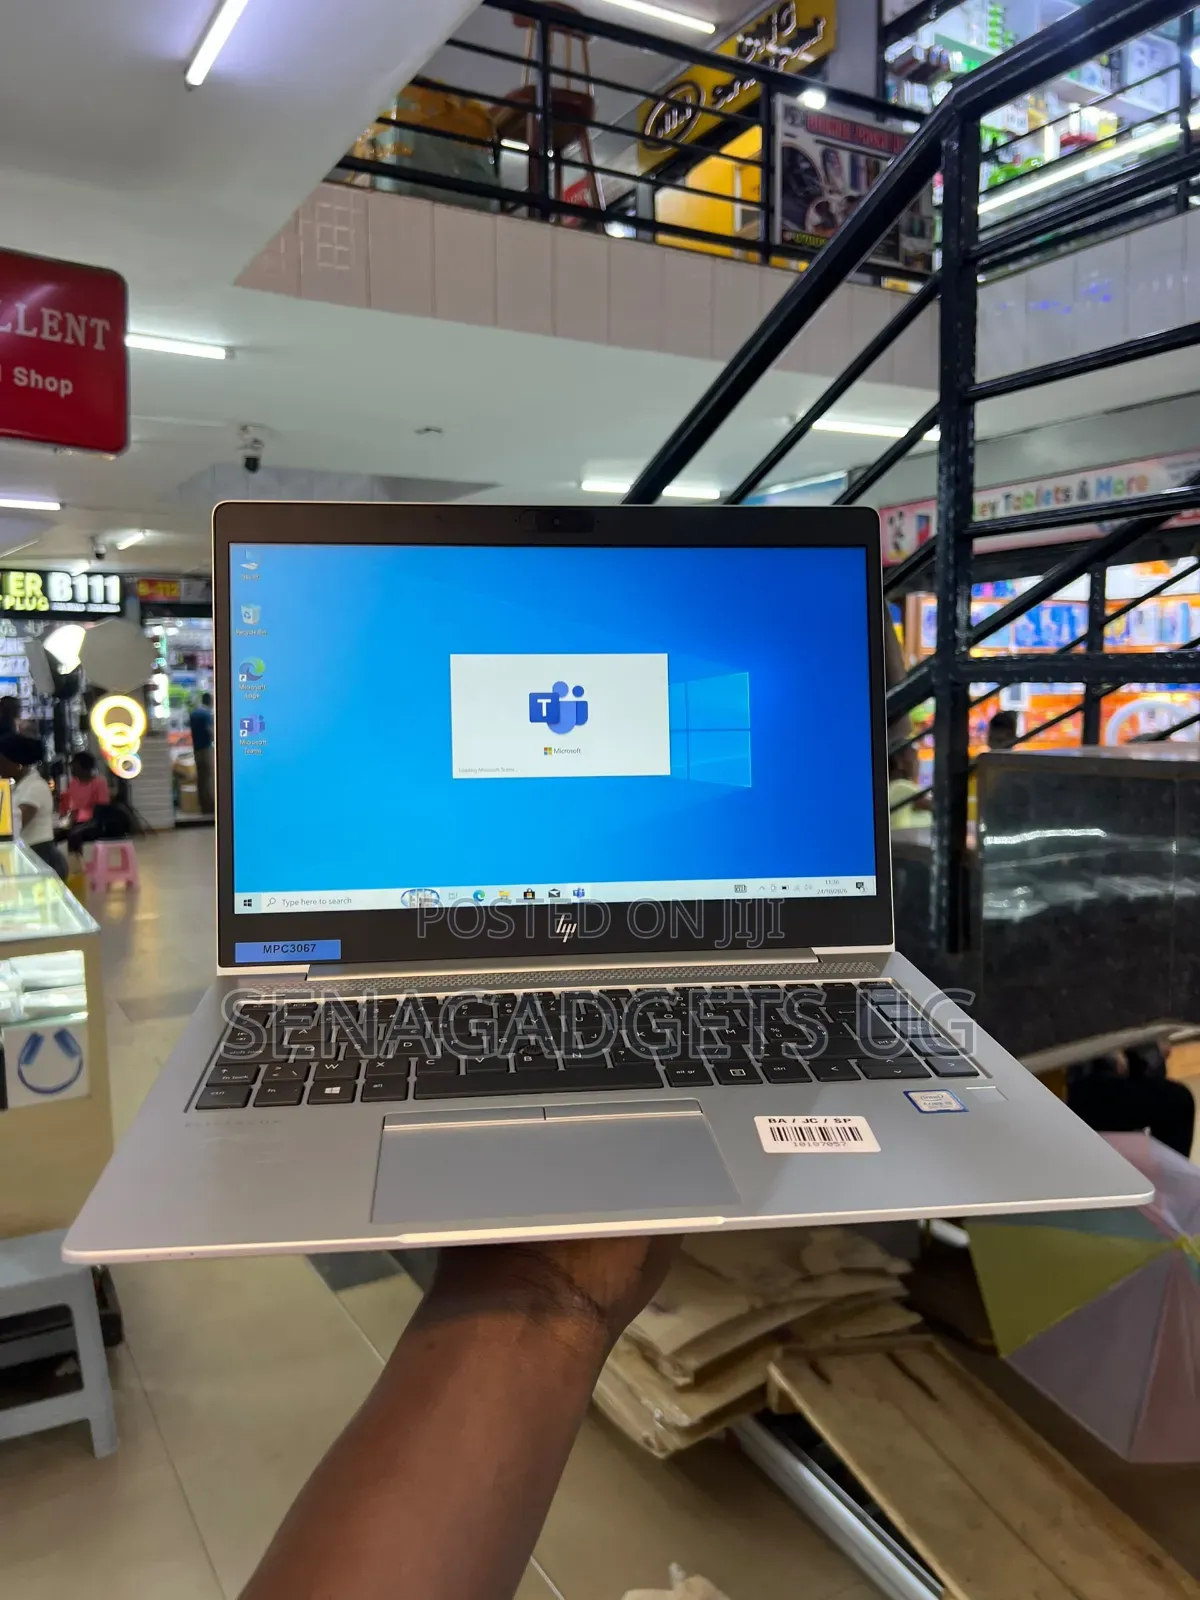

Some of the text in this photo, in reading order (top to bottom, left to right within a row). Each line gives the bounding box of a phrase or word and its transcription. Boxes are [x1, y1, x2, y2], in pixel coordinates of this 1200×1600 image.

[13, 366, 73, 398] Shop
[1003, 481, 1073, 512] Tablets
[1076, 477, 1090, 501] &
[1095, 474, 1149, 499] More
[48, 571, 120, 604] B111
[553, 747, 581, 755] Microsoft
[282, 898, 299, 907] Type
[556, 914, 577, 943] hp
[263, 944, 316, 954] MPC3067
